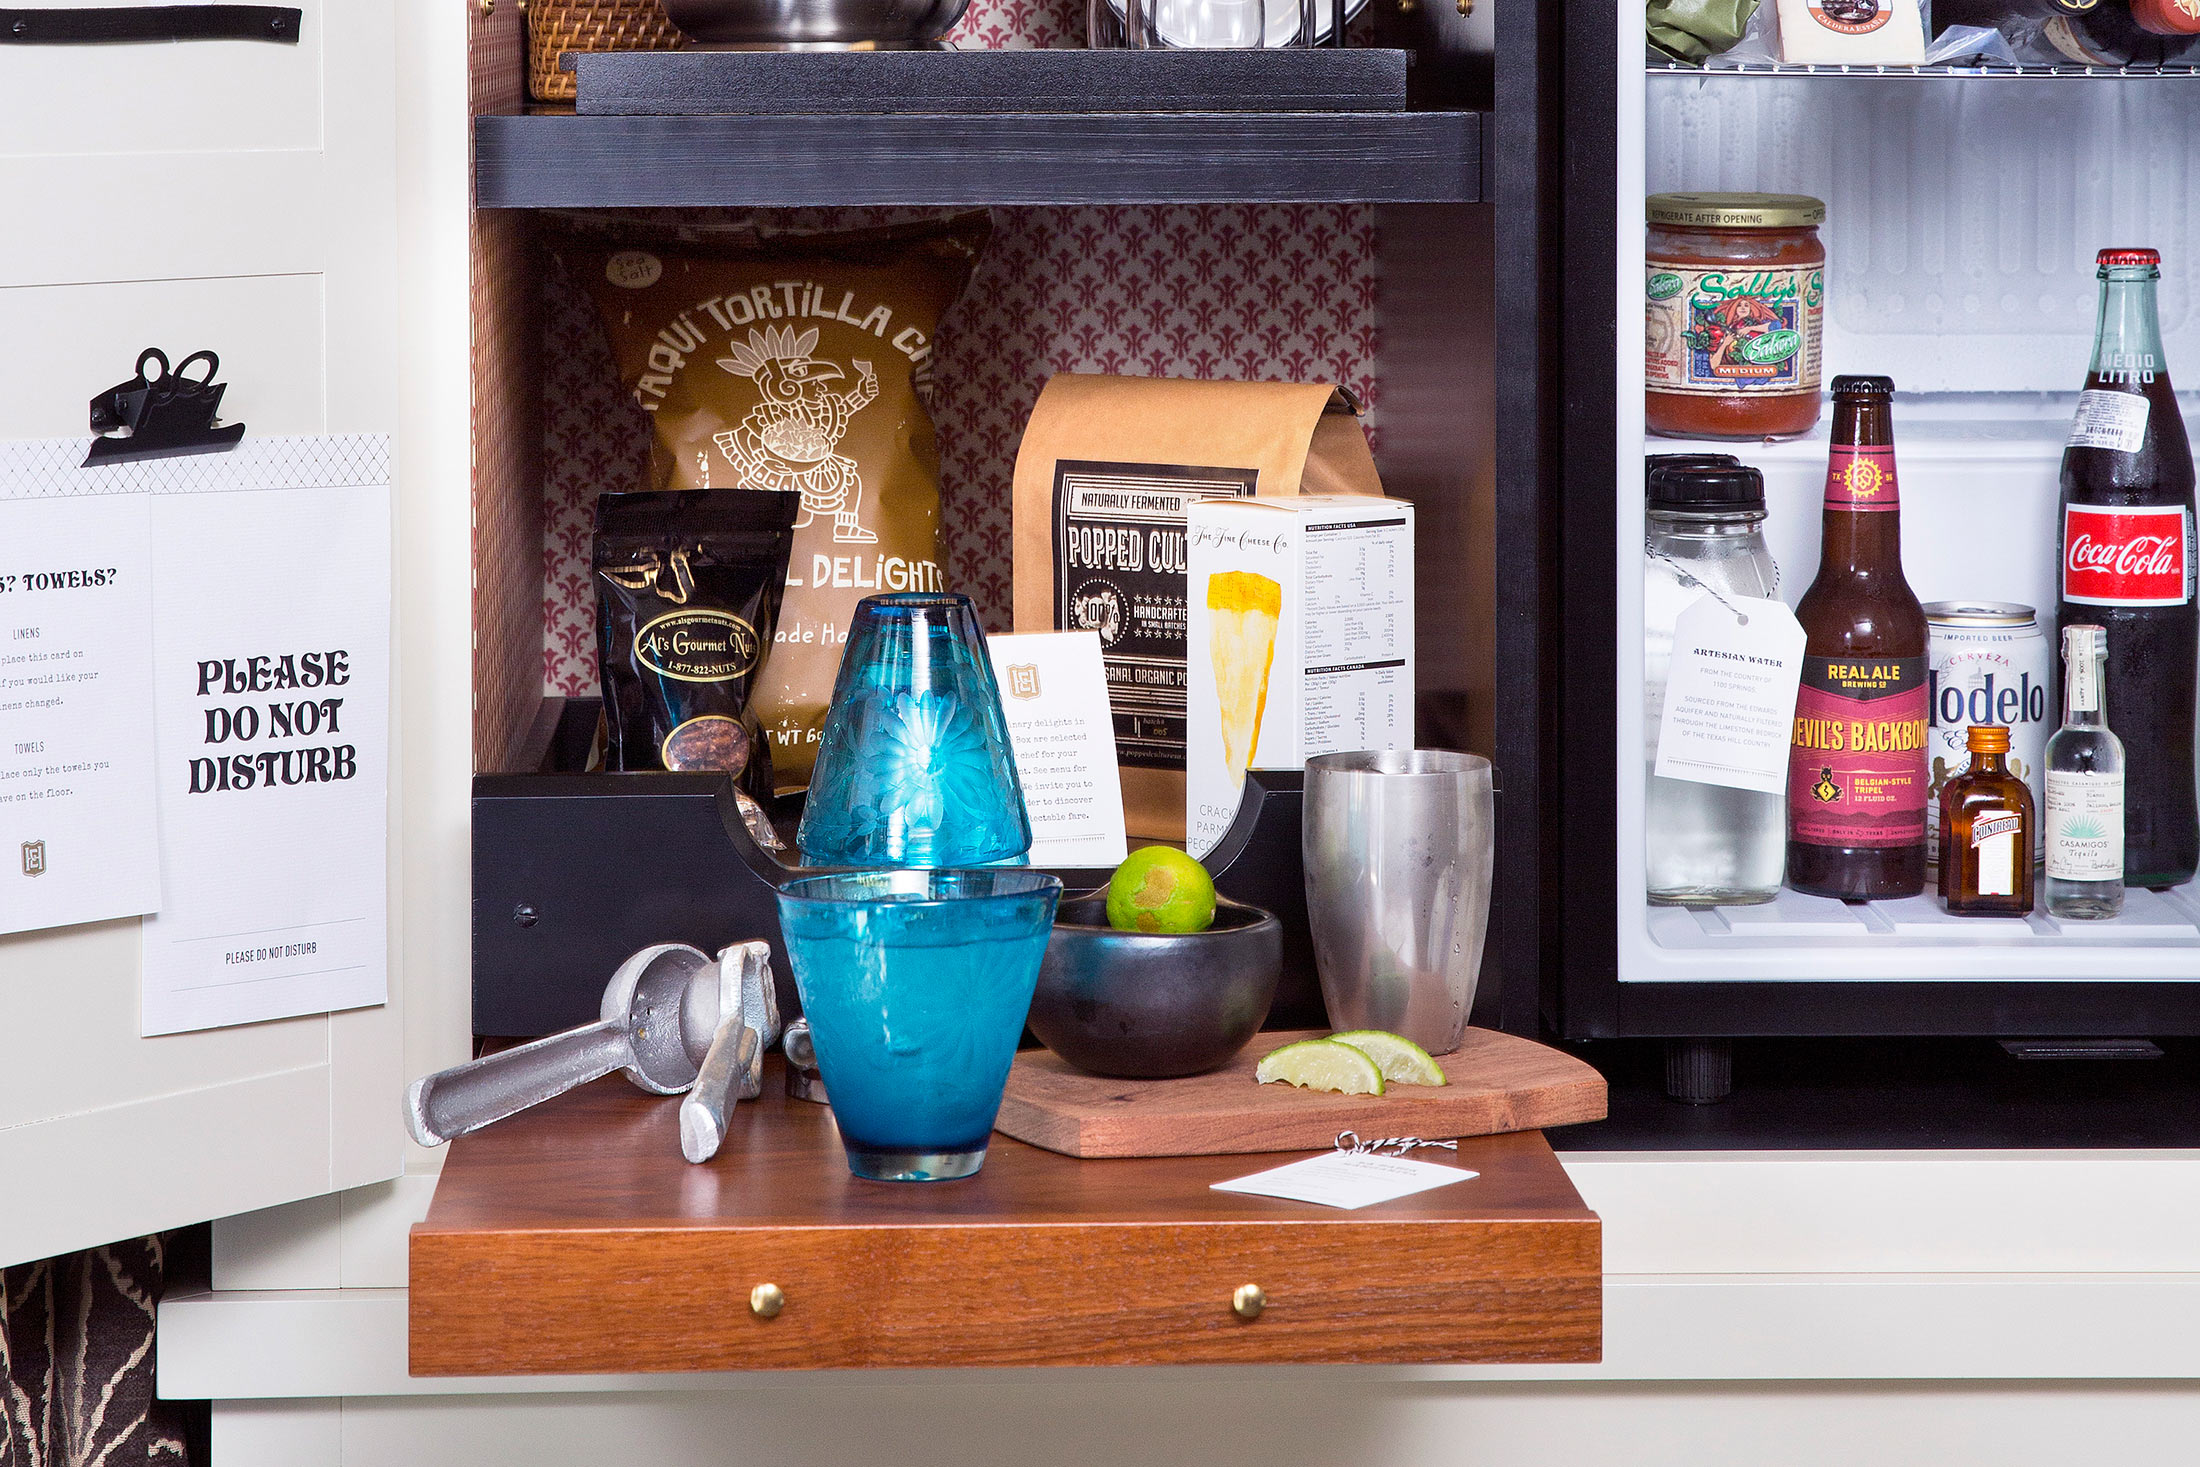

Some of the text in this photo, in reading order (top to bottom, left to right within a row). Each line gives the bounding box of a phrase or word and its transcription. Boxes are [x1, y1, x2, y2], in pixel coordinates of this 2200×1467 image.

[1696, 214, 1721, 223] AFTER
[1723, 214, 1763, 224] OPENING
[1691, 271, 1797, 309] Sally's
[2099, 353, 2155, 368] MEDIO
[1719, 366, 1775, 375] MEDIUM
[2098, 369, 2155, 384] LITRO
[1081, 492, 1181, 511] NATURALLY FERMENTED
[1067, 526, 1144, 572] POPPED
[2068, 533, 2178, 576] Coca-Cola
[22, 567, 118, 592] TOWELS?
[1133, 605, 1187, 621] HANDCRAFTE
[659, 616, 742, 632] www.alsgourmetnuts.com
[1148, 620, 1163, 629] SMALL
[1164, 621, 1186, 630] BATCHES
[13, 627, 41, 641] LINENS
[774, 622, 815, 644] ade
[1943, 633, 1989, 642] IMPORTED
[640, 630, 757, 659] Al's Gourmet Nuts
[1, 649, 84, 667] place this card on
[1693, 647, 1783, 668] ARTESIAN WATER
[1949, 652, 2010, 667] CERVEZA
[196, 650, 350, 696] PLEASE
[667, 660, 737, 674] 1-877-822-NUTS
[1700, 667, 1719, 676] FROM
[1720, 670, 1732, 678] THE
[1733, 671, 1763, 682] COUNTRY
[1828, 664, 1901, 680] REAL ALE
[9, 678, 25, 689] you
[27, 674, 54, 686] would
[56, 671, 76, 683] like
[78, 671, 99, 683] your
[1105, 667, 1133, 683] SANAL
[1134, 669, 1175, 686] ORGANIC
[1842, 681, 1877, 689] BREWING
[0, 696, 64, 711] nens changed.
[1684, 696, 1778, 715] SOURCED FROM THE EDWARDS
[204, 697, 344, 744] DO NOT
[1007, 717, 1085, 729] inary delights in
[1675, 706, 1783, 728] AQUIFER AND NATURALLY FILTERED
[1673, 717, 1782, 739] THROUGH THE LIMESTONE BEDROCK
[777, 729, 803, 746] WT
[1050, 733, 1087, 742] selected
[1692, 731, 1705, 739] THE
[1706, 733, 1727, 743] TEXAS
[15, 740, 45, 754] TOWELS
[1020, 750, 1078, 759] chef for your
[0, 759, 110, 780] lace only the towels you
[188, 744, 357, 794] DISTURB
[1033, 766, 1048, 774] See
[1050, 766, 1071, 774] menu
[1035, 781, 1064, 790] invite
[1066, 781, 1082, 790] you
[1854, 777, 1912, 786] BELGIAN-STYLE
[16, 793, 27, 802] on
[29, 788, 44, 800] the
[47, 786, 74, 799] floor.
[1855, 786, 1883, 794] TRIPEL
[1026, 797, 1093, 806] der to discover
[1029, 812, 1089, 822] lectable fare.
[1199, 804, 1234, 820] CRACK
[1196, 821, 1228, 835] PARM
[1973, 817, 2019, 842] COINTREAU
[1187, 837, 1214, 851] PECO
[2060, 839, 2109, 849] CASAMIGOS
[2068, 849, 2099, 859] Tequila
[225, 941, 317, 964] PLEASE DO NOT DISTURB
